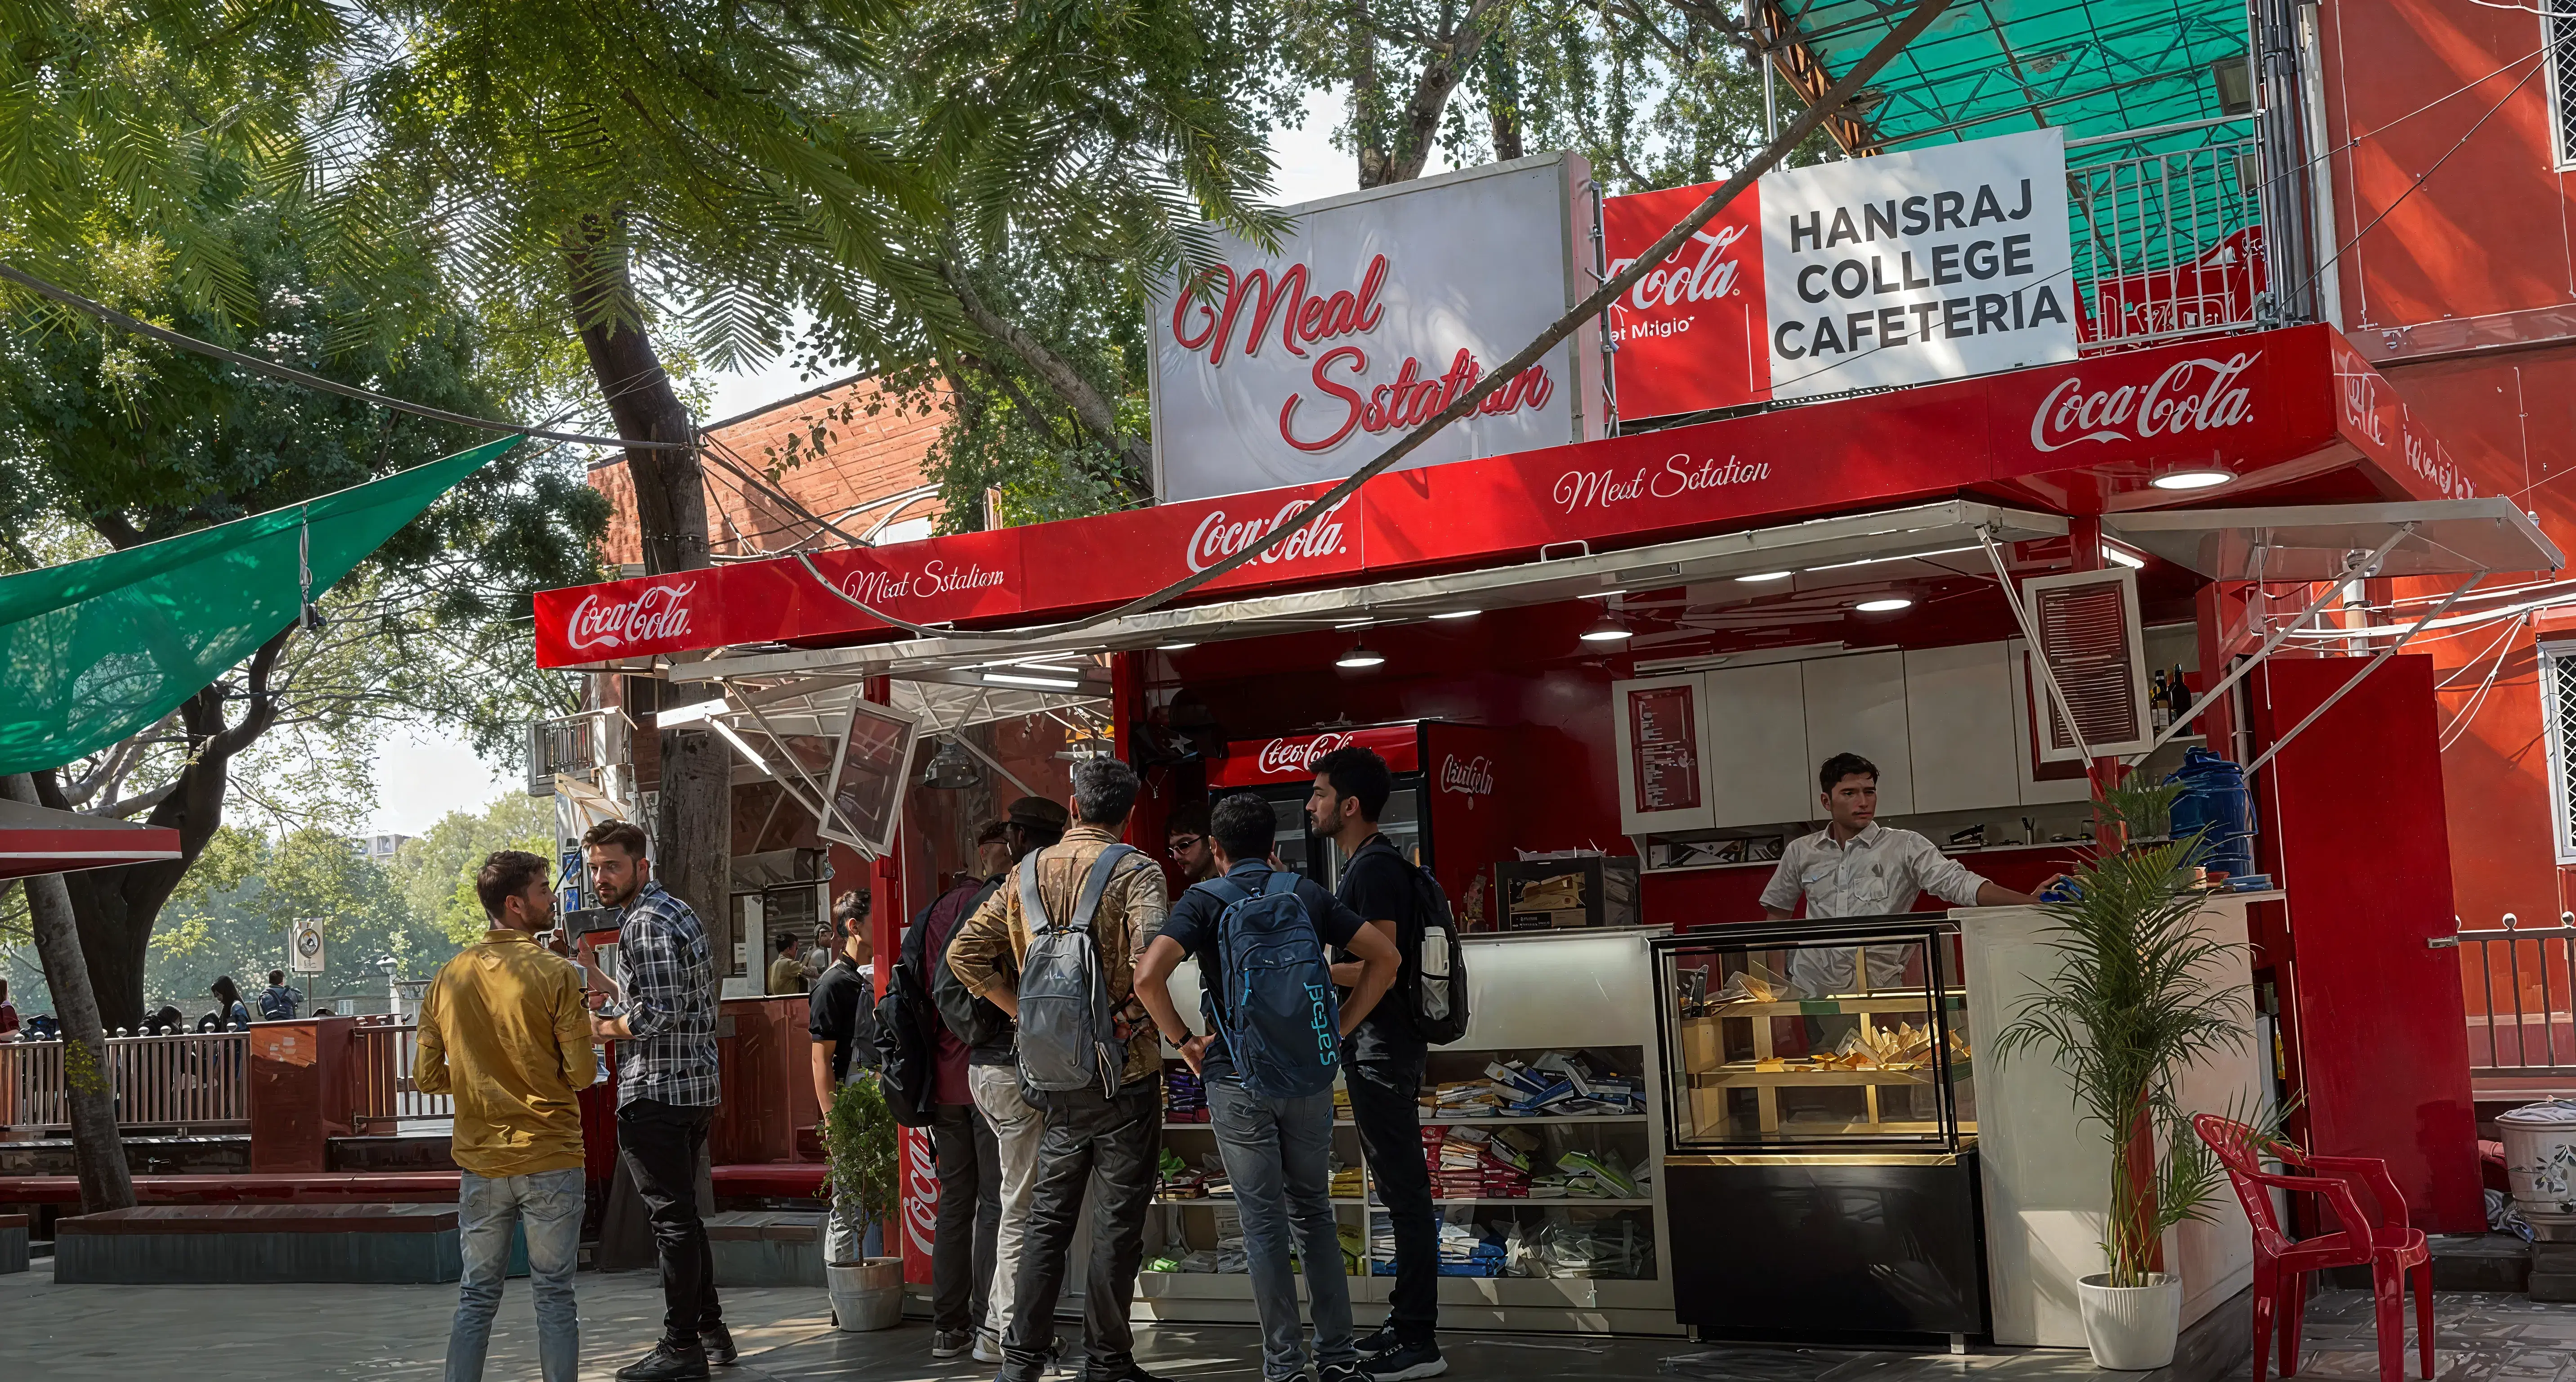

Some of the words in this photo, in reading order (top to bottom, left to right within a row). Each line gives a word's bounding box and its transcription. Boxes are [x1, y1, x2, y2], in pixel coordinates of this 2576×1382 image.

[1790, 179, 2032, 253] HANSRAJ
[1798, 233, 2034, 304] COLLEGE
[1172, 253, 1389, 365] Meal
[1774, 285, 2067, 359] CAFETERIA
